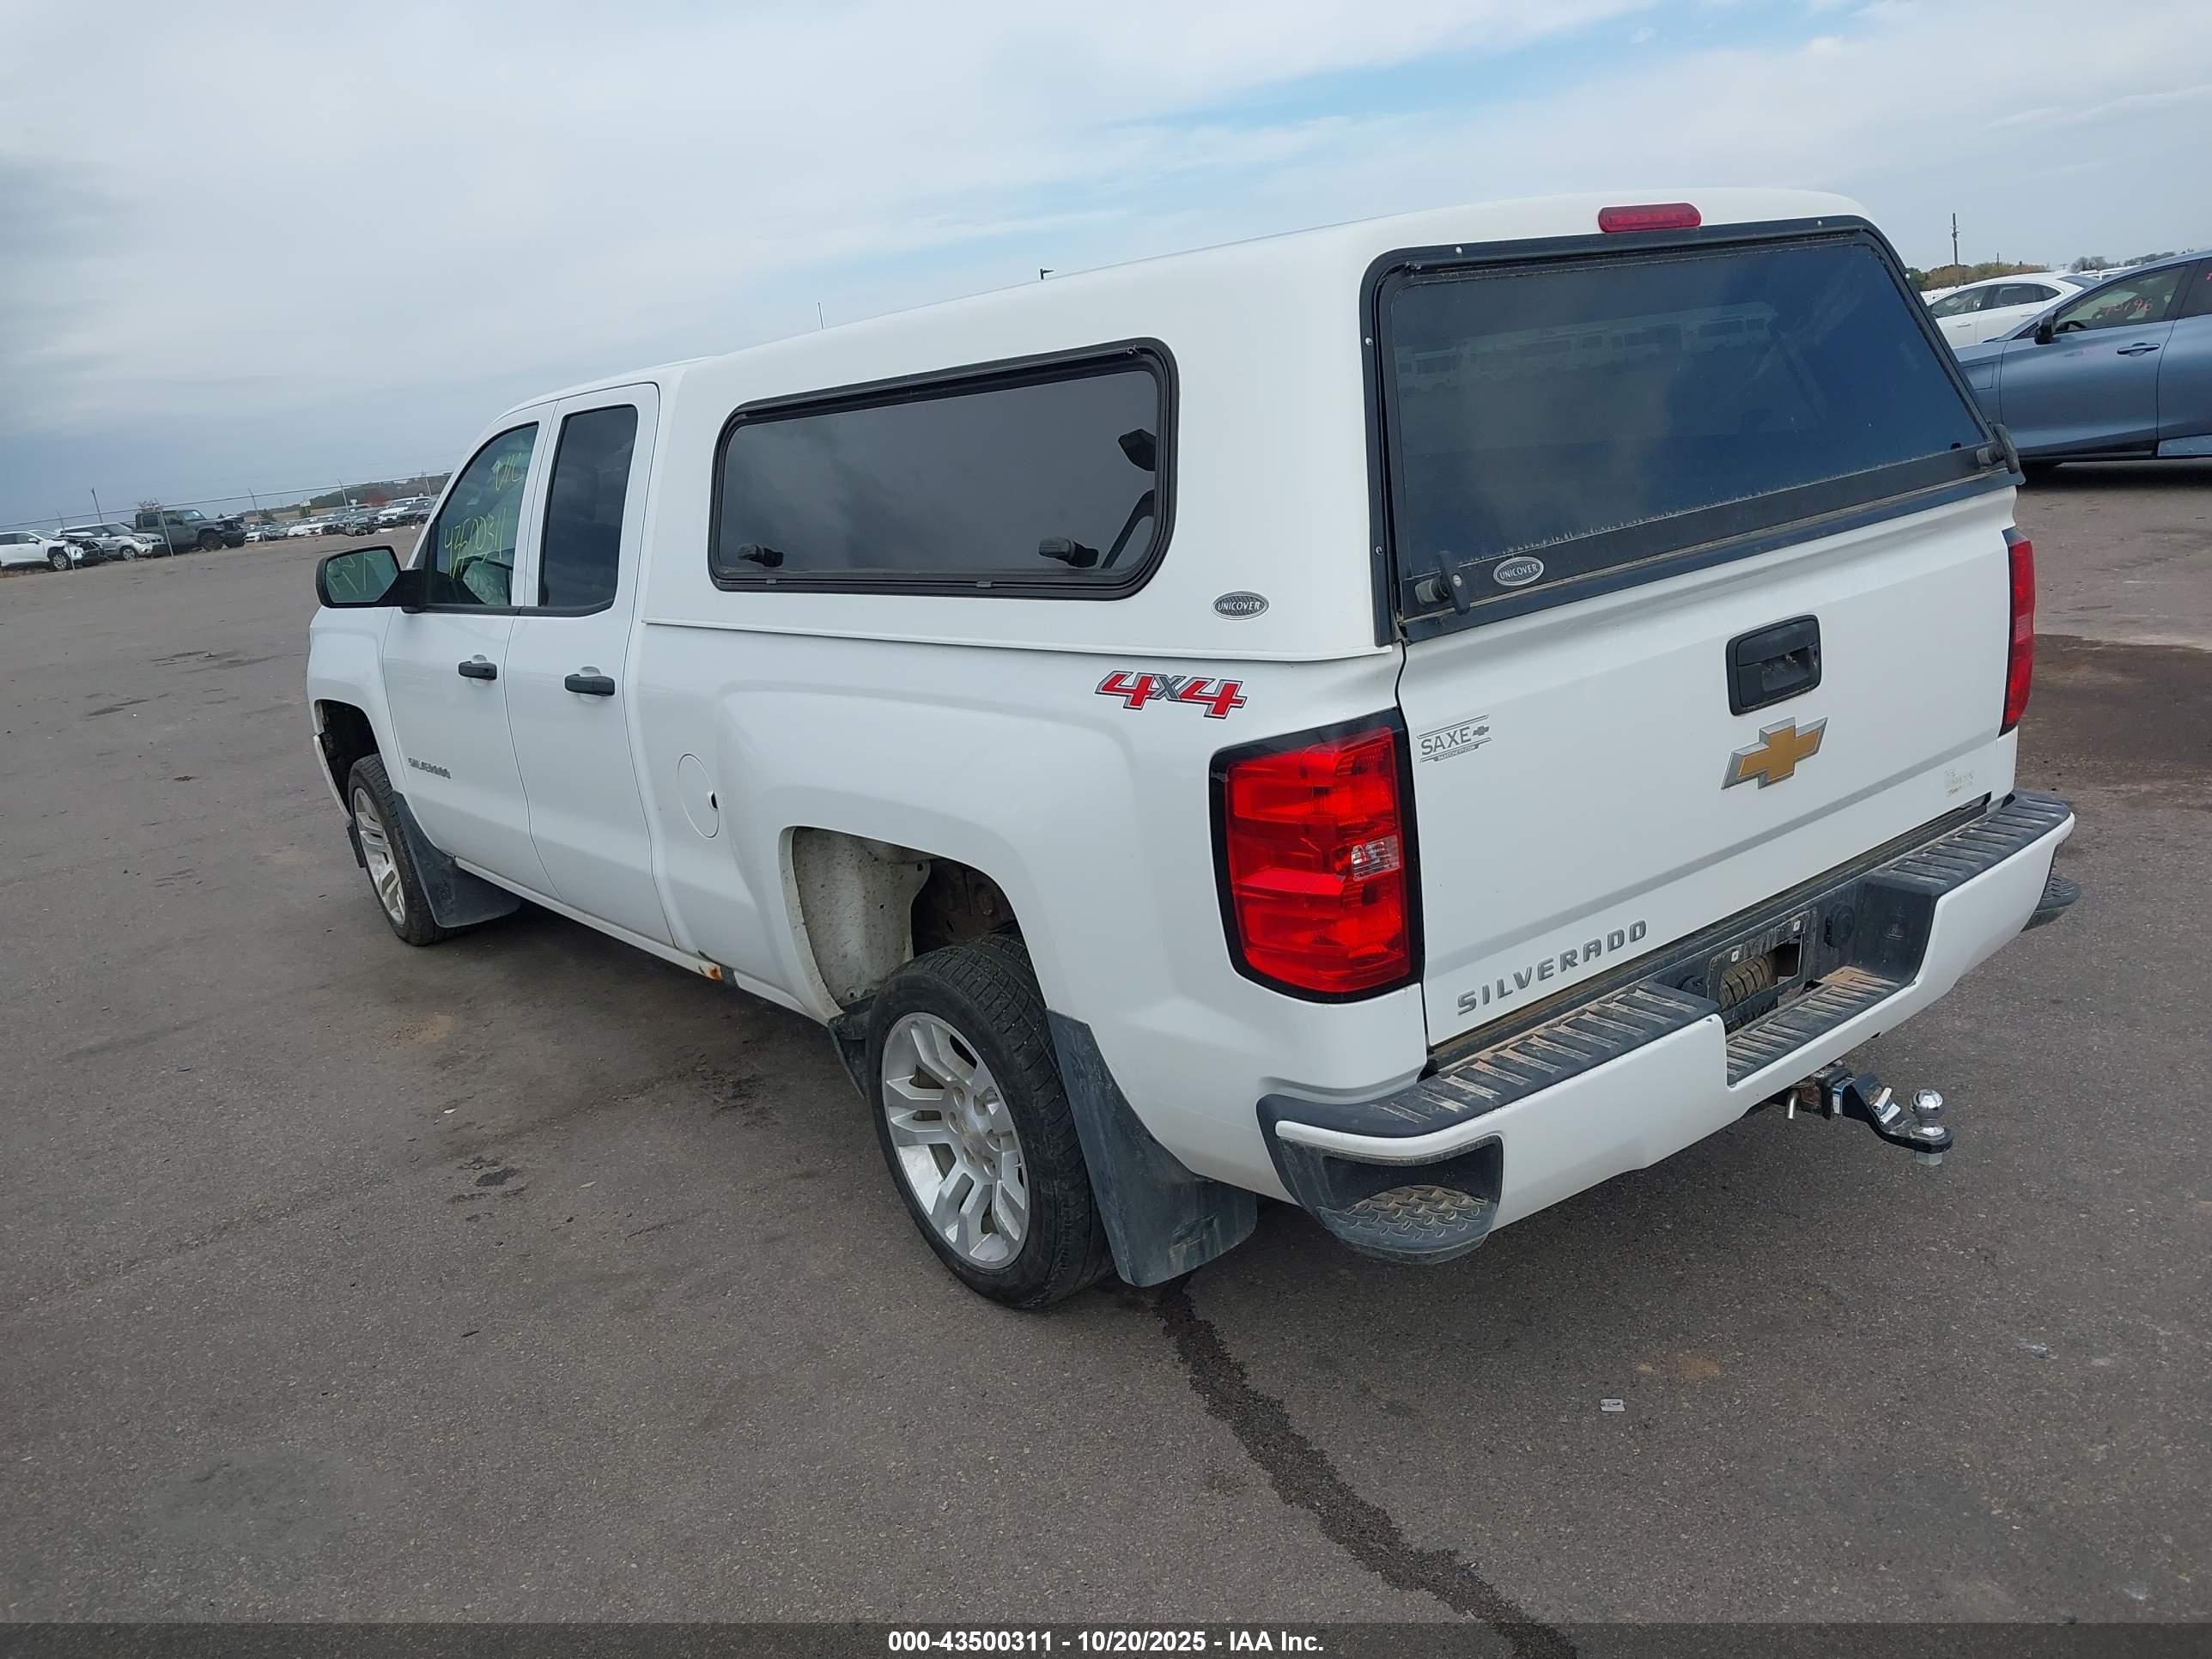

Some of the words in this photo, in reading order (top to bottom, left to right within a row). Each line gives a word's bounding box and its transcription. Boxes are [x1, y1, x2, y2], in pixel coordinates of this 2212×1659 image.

[1499, 563, 1538, 580] UNICOVER
[1218, 601, 1261, 611] UNICOVER
[1420, 726, 1472, 756] SAXE
[1457, 920, 1647, 1016] SILVERADO
